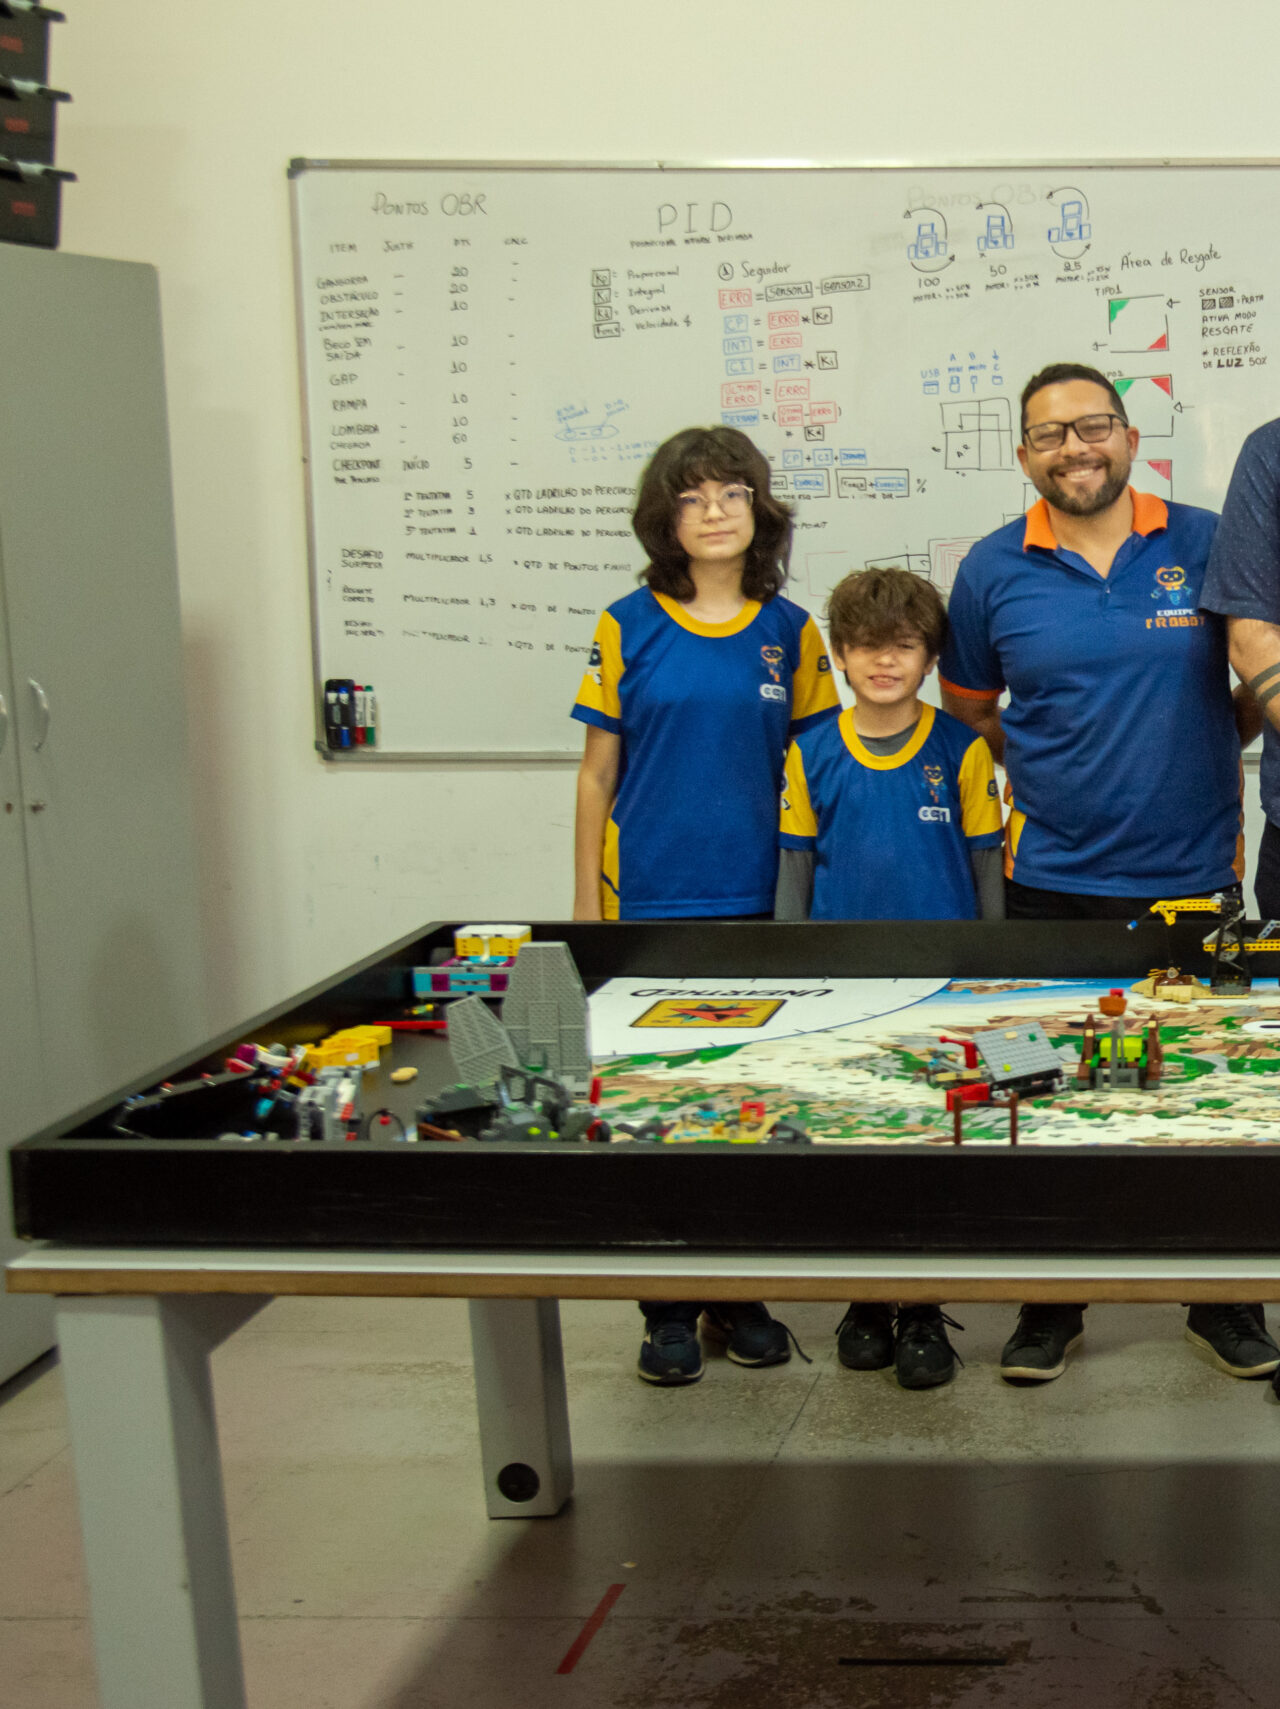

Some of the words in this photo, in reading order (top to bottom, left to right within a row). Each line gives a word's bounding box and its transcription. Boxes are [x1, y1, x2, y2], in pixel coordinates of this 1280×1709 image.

[440, 193, 488, 217] OBR
[1121, 251, 1151, 271] Área
[1161, 250, 1174, 266] de
[1180, 243, 1221, 272] Resgate
[451, 266, 469, 277] 20
[989, 264, 1007, 278] 50
[918, 277, 941, 288] 100
[1199, 286, 1236, 297] SENSOR
[721, 292, 750, 305] ERRO
[450, 301, 469, 311] 10
[771, 313, 798, 327] ERRO
[1202, 314, 1230, 323] ATIVA
[1234, 311, 1257, 320] MODO
[1201, 323, 1254, 338] RESGATE
[451, 335, 469, 347] 10
[727, 339, 747, 350] INT
[450, 361, 468, 374] 10
[777, 358, 795, 367] INT
[1216, 358, 1244, 368] LUZ
[920, 368, 940, 379] USB
[329, 373, 359, 386] GAP
[778, 385, 808, 396] ERRO
[451, 393, 469, 404] 10
[452, 416, 469, 427] 10
[452, 433, 468, 444] 60
[463, 457, 473, 470] 5
